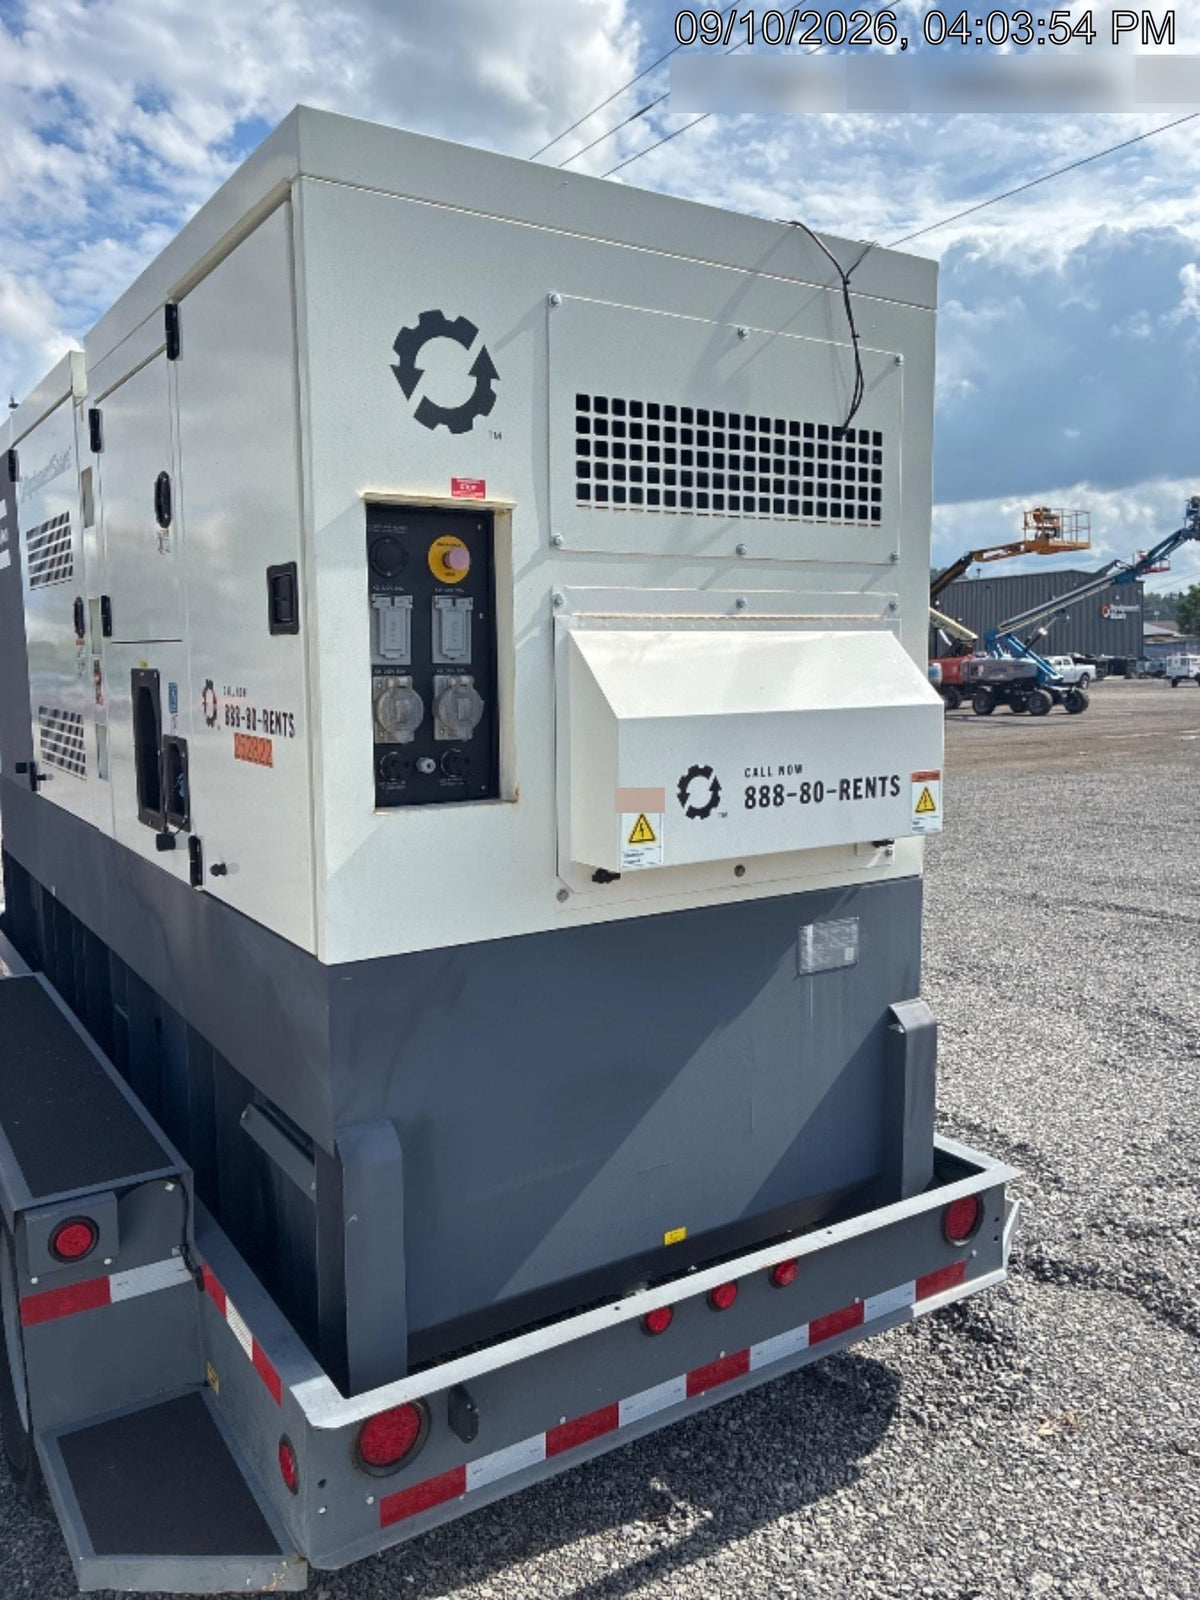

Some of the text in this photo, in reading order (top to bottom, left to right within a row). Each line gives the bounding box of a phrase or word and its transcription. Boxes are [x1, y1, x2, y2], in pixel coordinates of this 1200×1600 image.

[744, 763, 803, 778] CALL NOW
[744, 774, 901, 810] 888-80-RENTS
